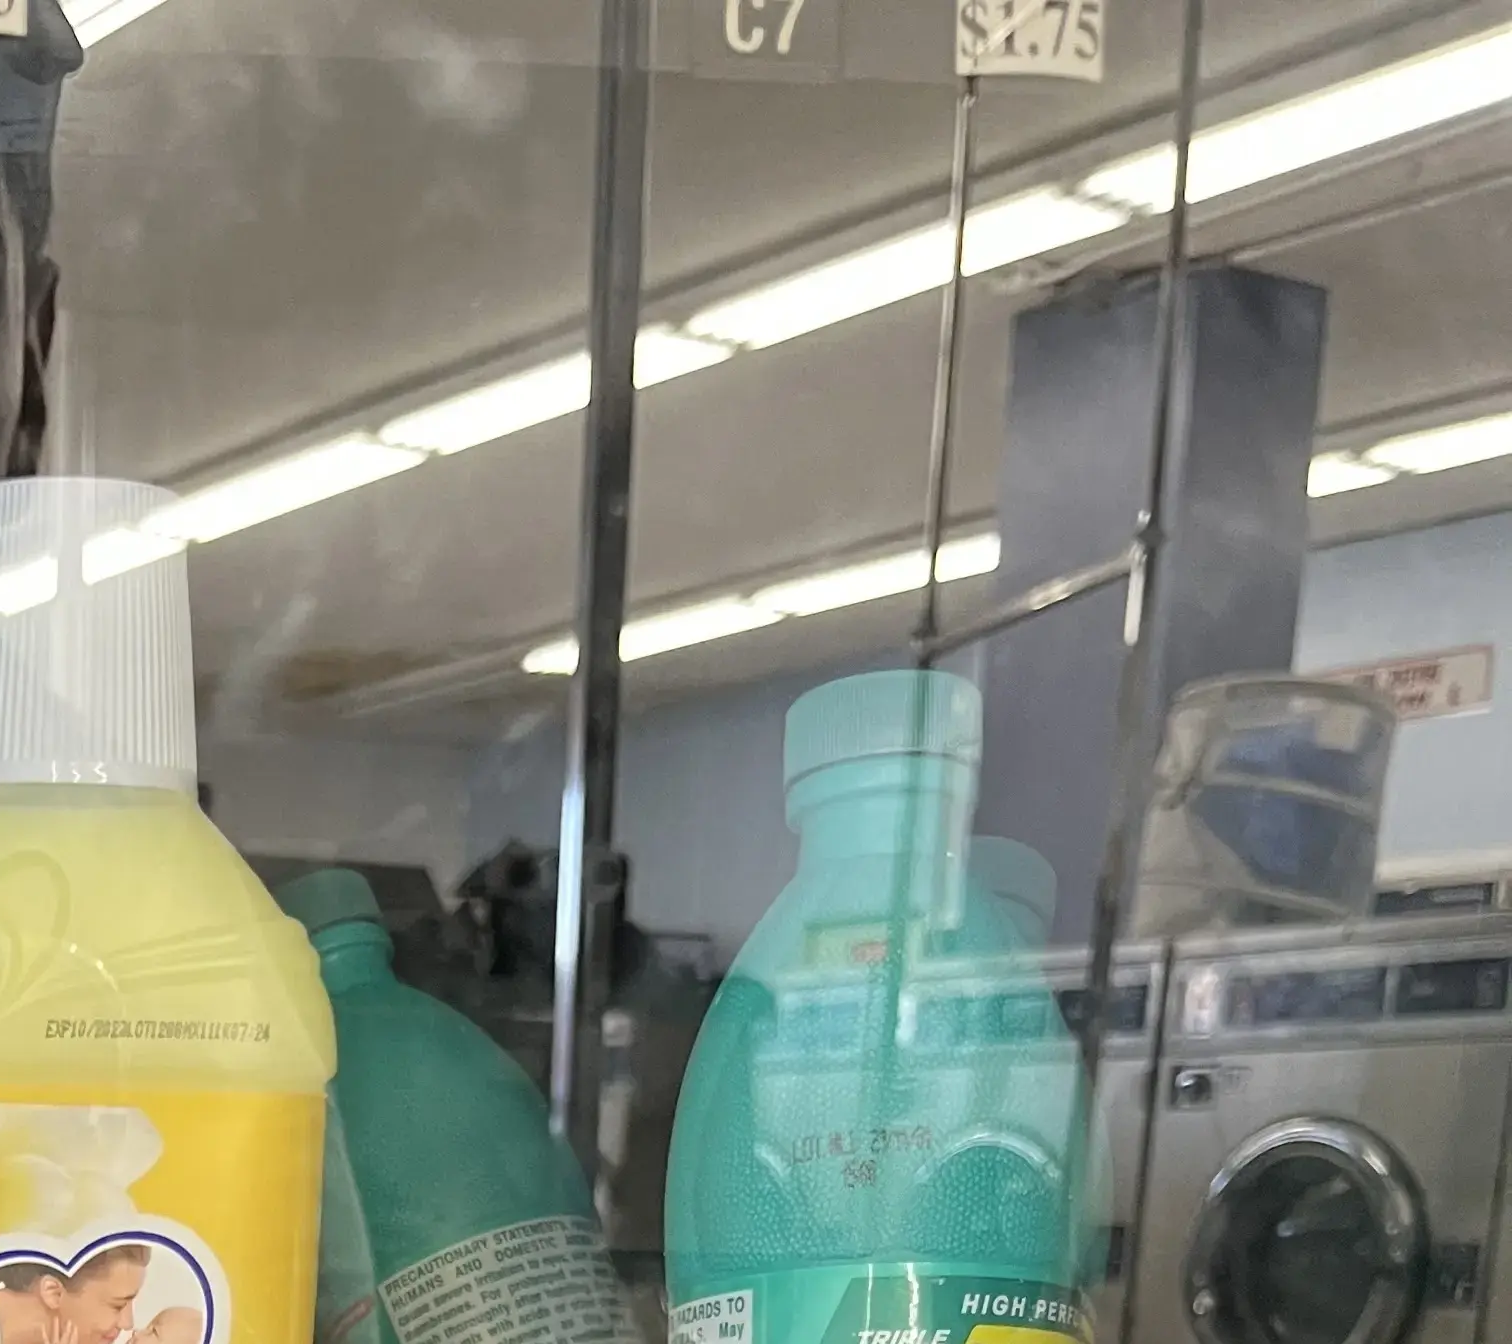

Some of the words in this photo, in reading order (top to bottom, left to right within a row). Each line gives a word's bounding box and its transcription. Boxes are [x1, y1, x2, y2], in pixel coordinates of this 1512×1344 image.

[725, 0, 803, 54] C7
[960, 0, 1100, 66] $1.75
[384, 1237, 488, 1295] PRECAUTIONARY
[455, 1258, 482, 1278] AND
[494, 1236, 558, 1263] DOMESTIC
[727, 1296, 745, 1315] TO
[960, 1293, 1027, 1318] HIGH
[719, 1322, 744, 1341] May
